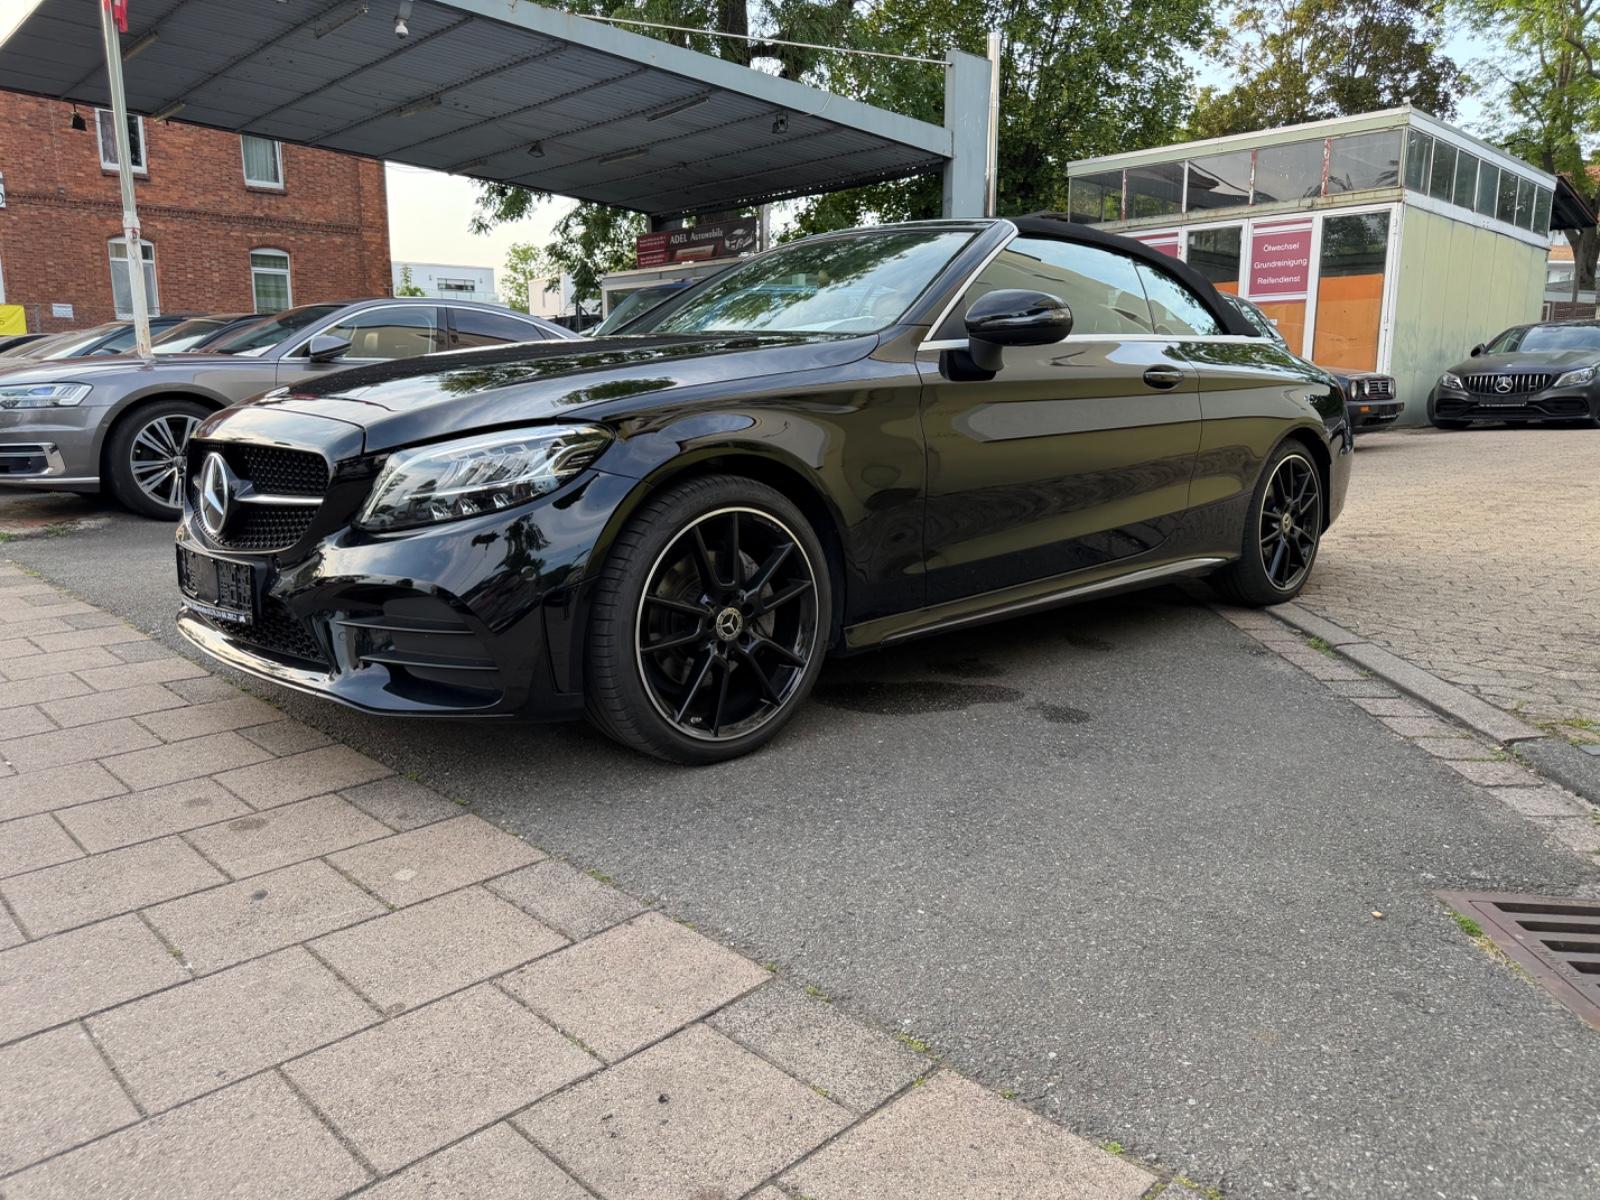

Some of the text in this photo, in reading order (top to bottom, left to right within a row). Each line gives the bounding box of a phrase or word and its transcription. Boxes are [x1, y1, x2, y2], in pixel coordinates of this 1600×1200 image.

[670, 233, 687, 244] ADEL
[1253, 258, 1307, 269] Grundreinigung
[1257, 276, 1300, 285] Reifendienst
